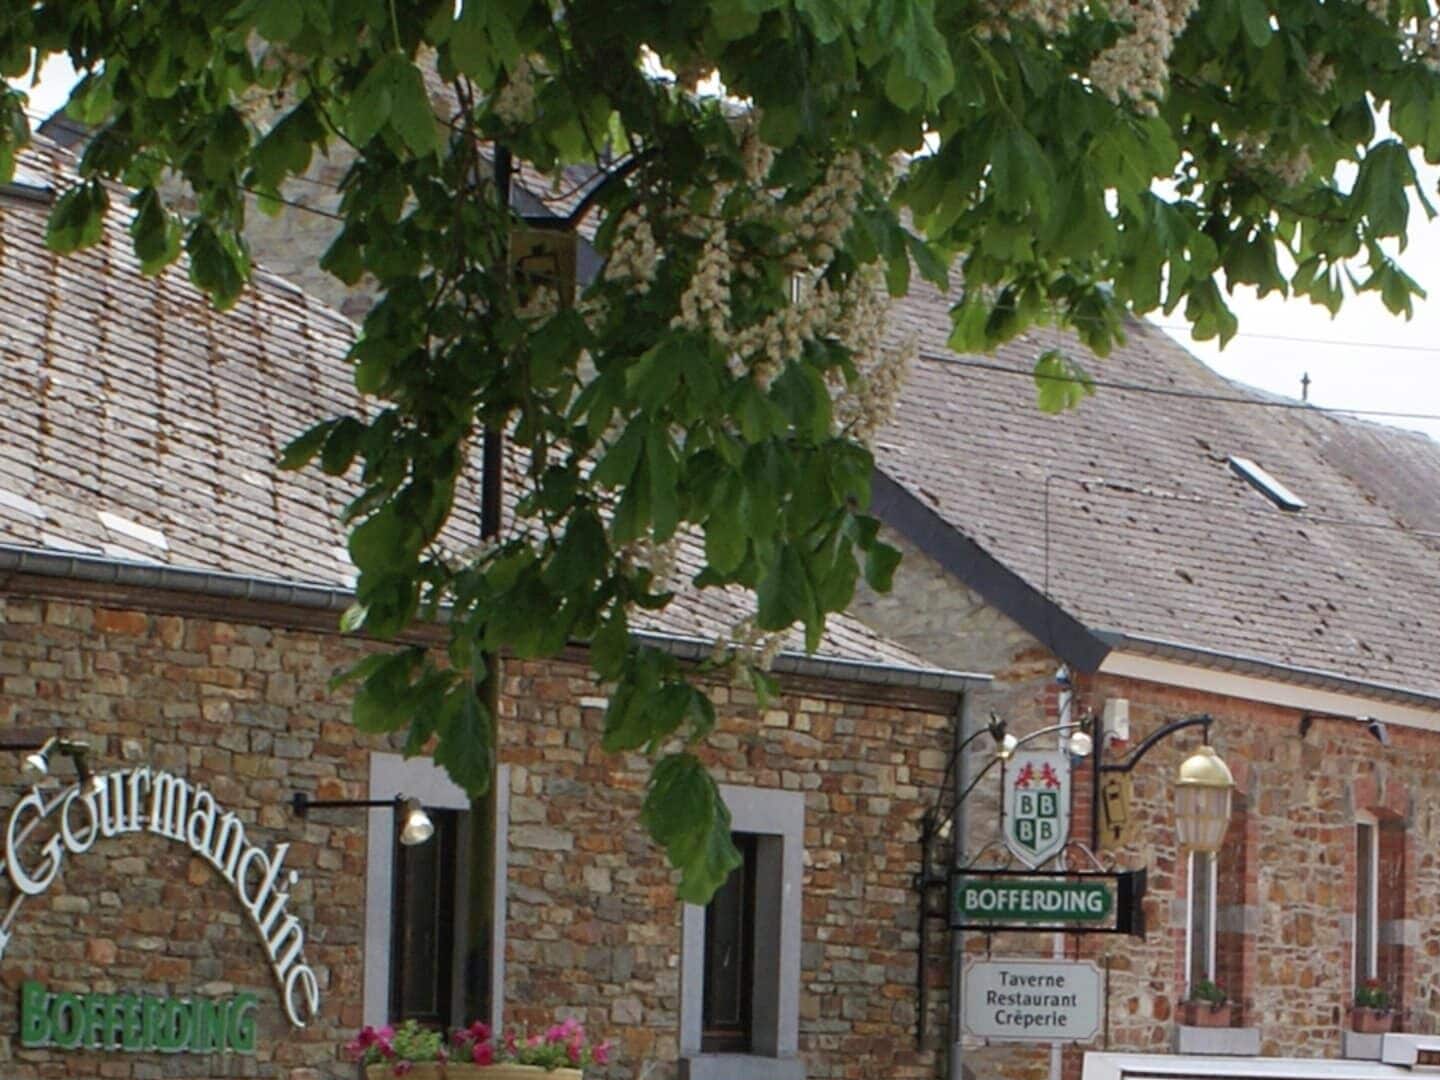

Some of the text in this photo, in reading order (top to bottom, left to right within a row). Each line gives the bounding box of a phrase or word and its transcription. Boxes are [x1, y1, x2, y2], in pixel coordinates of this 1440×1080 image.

[6, 766, 320, 1028] Gourmandine
[964, 888, 1104, 912] BOFFERDING
[998, 970, 1065, 988] Taverne
[986, 989, 1077, 1008] Restaurant
[21, 980, 258, 1055] BOFFERDING
